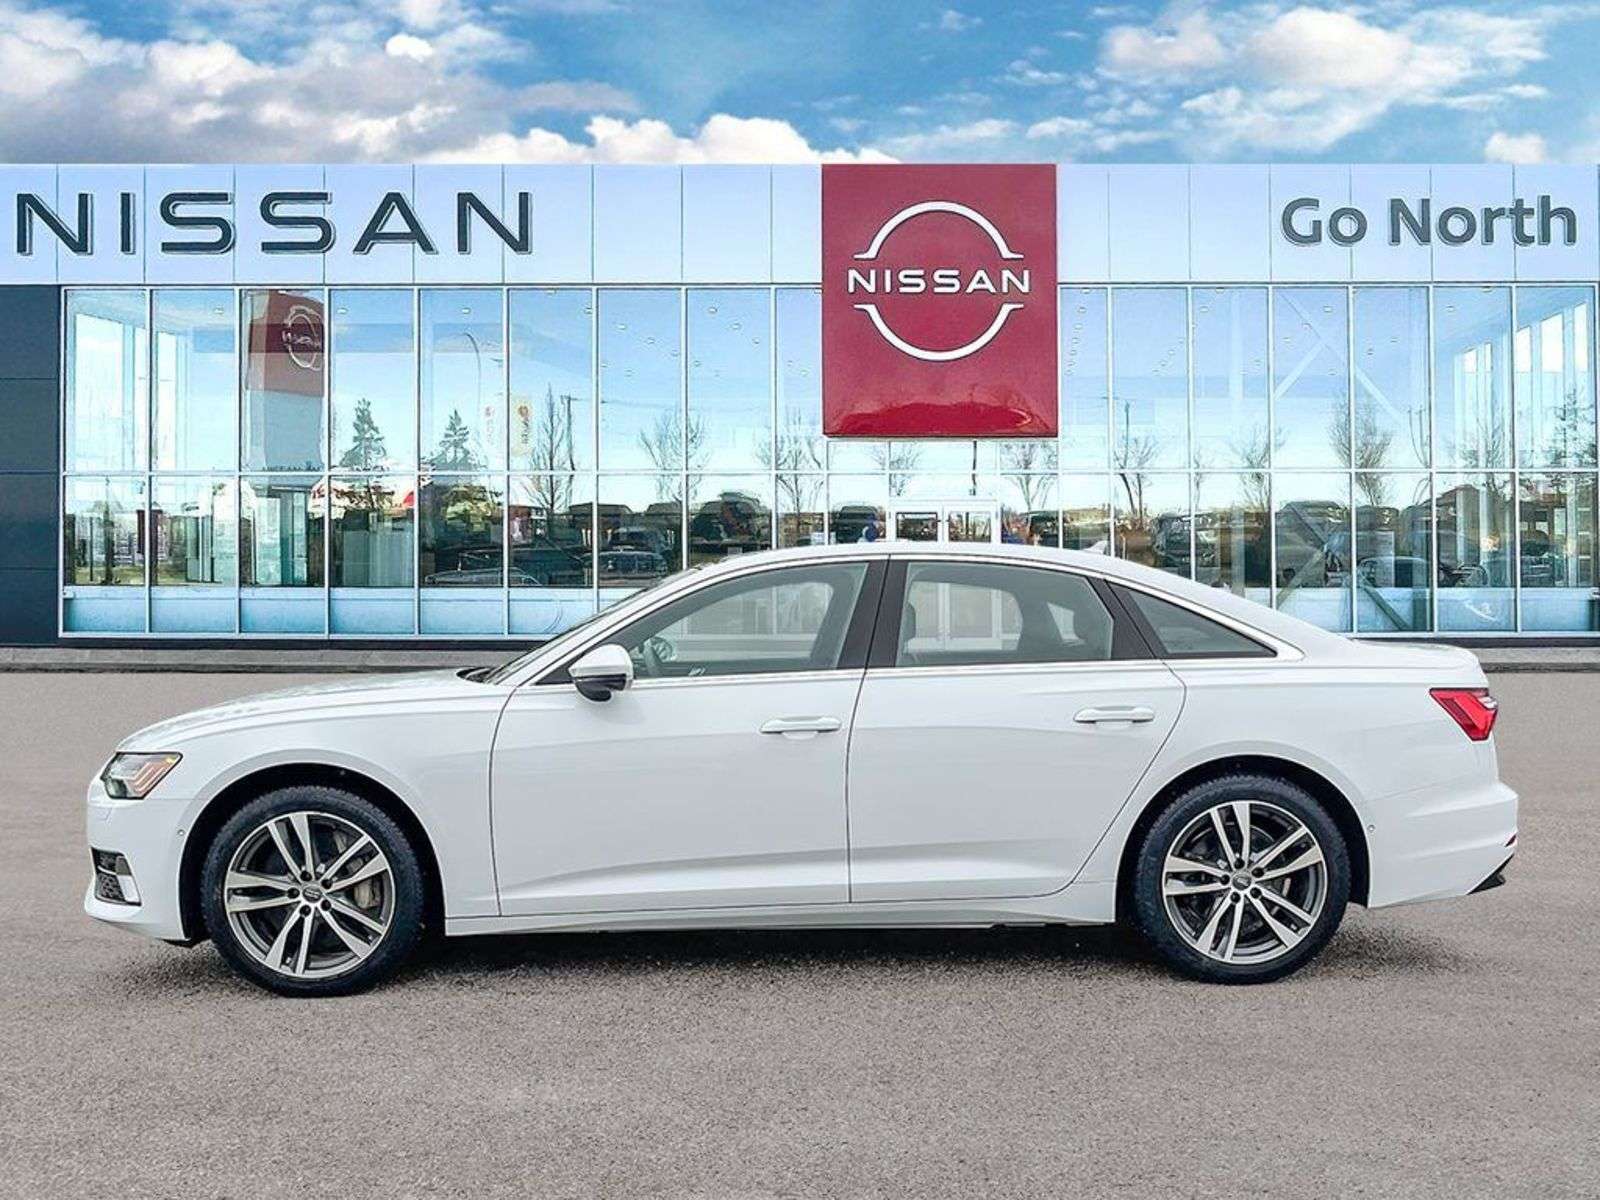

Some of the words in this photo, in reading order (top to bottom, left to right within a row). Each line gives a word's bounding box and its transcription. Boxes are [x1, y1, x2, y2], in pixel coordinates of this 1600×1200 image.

[16, 191, 534, 256] NISSAN
[1281, 196, 1368, 247] Go
[1389, 194, 1578, 247] North
[846, 268, 1031, 295] NISSAN
